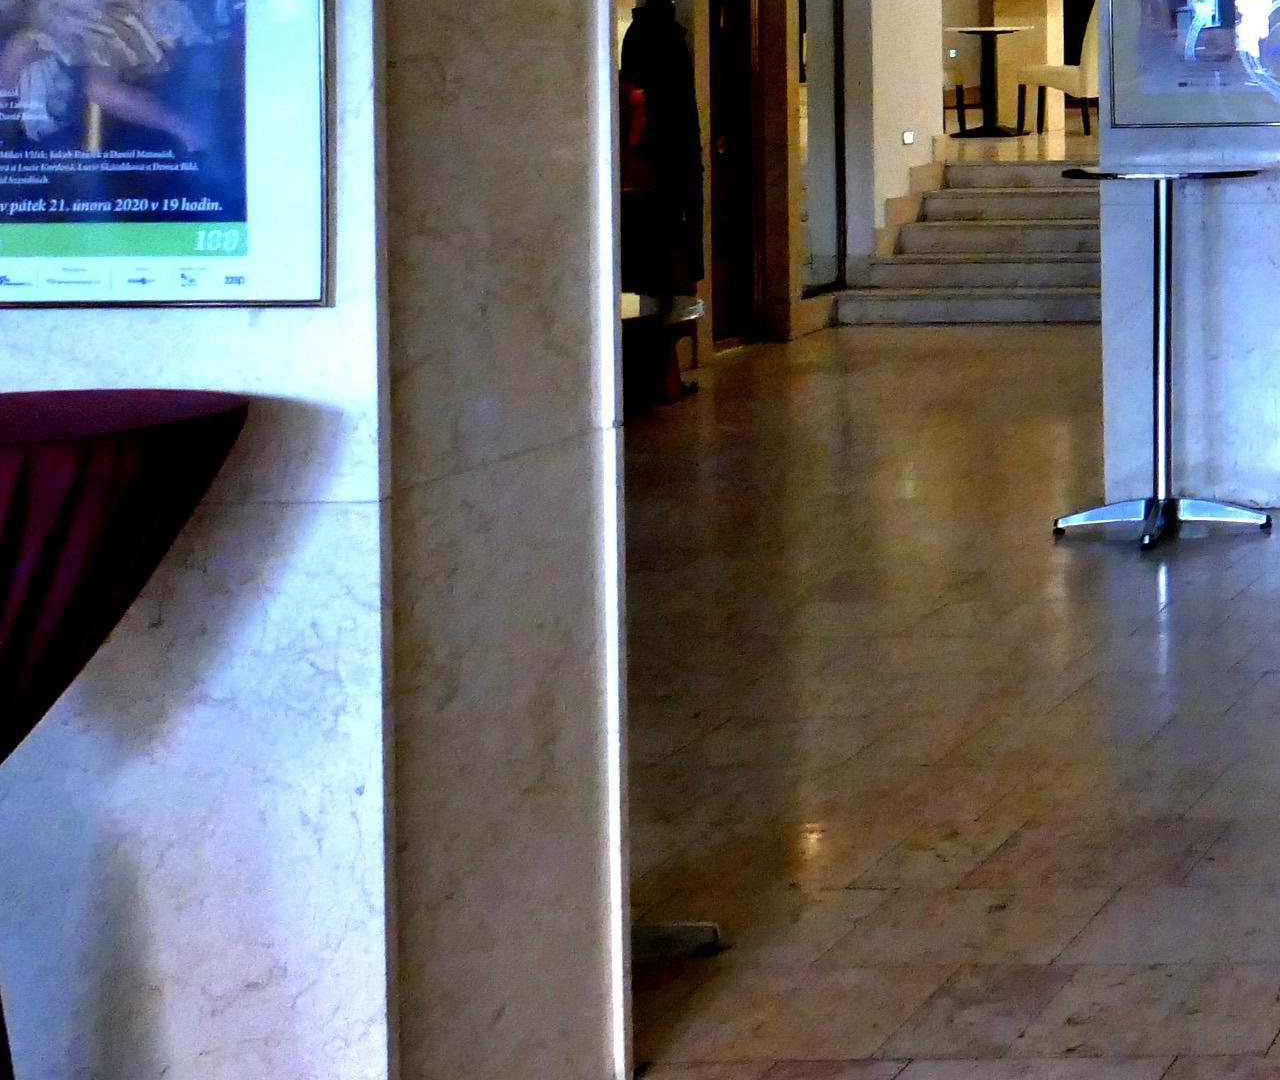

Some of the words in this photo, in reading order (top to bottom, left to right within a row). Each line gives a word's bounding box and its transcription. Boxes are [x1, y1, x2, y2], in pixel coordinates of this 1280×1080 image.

[10, 198, 47, 216] pátek
[48, 199, 71, 212] 21.
[73, 199, 112, 212] února
[113, 198, 148, 211] 2020
[151, 201, 159, 211] v
[162, 198, 179, 211] 19
[181, 196, 223, 212] hodin.
